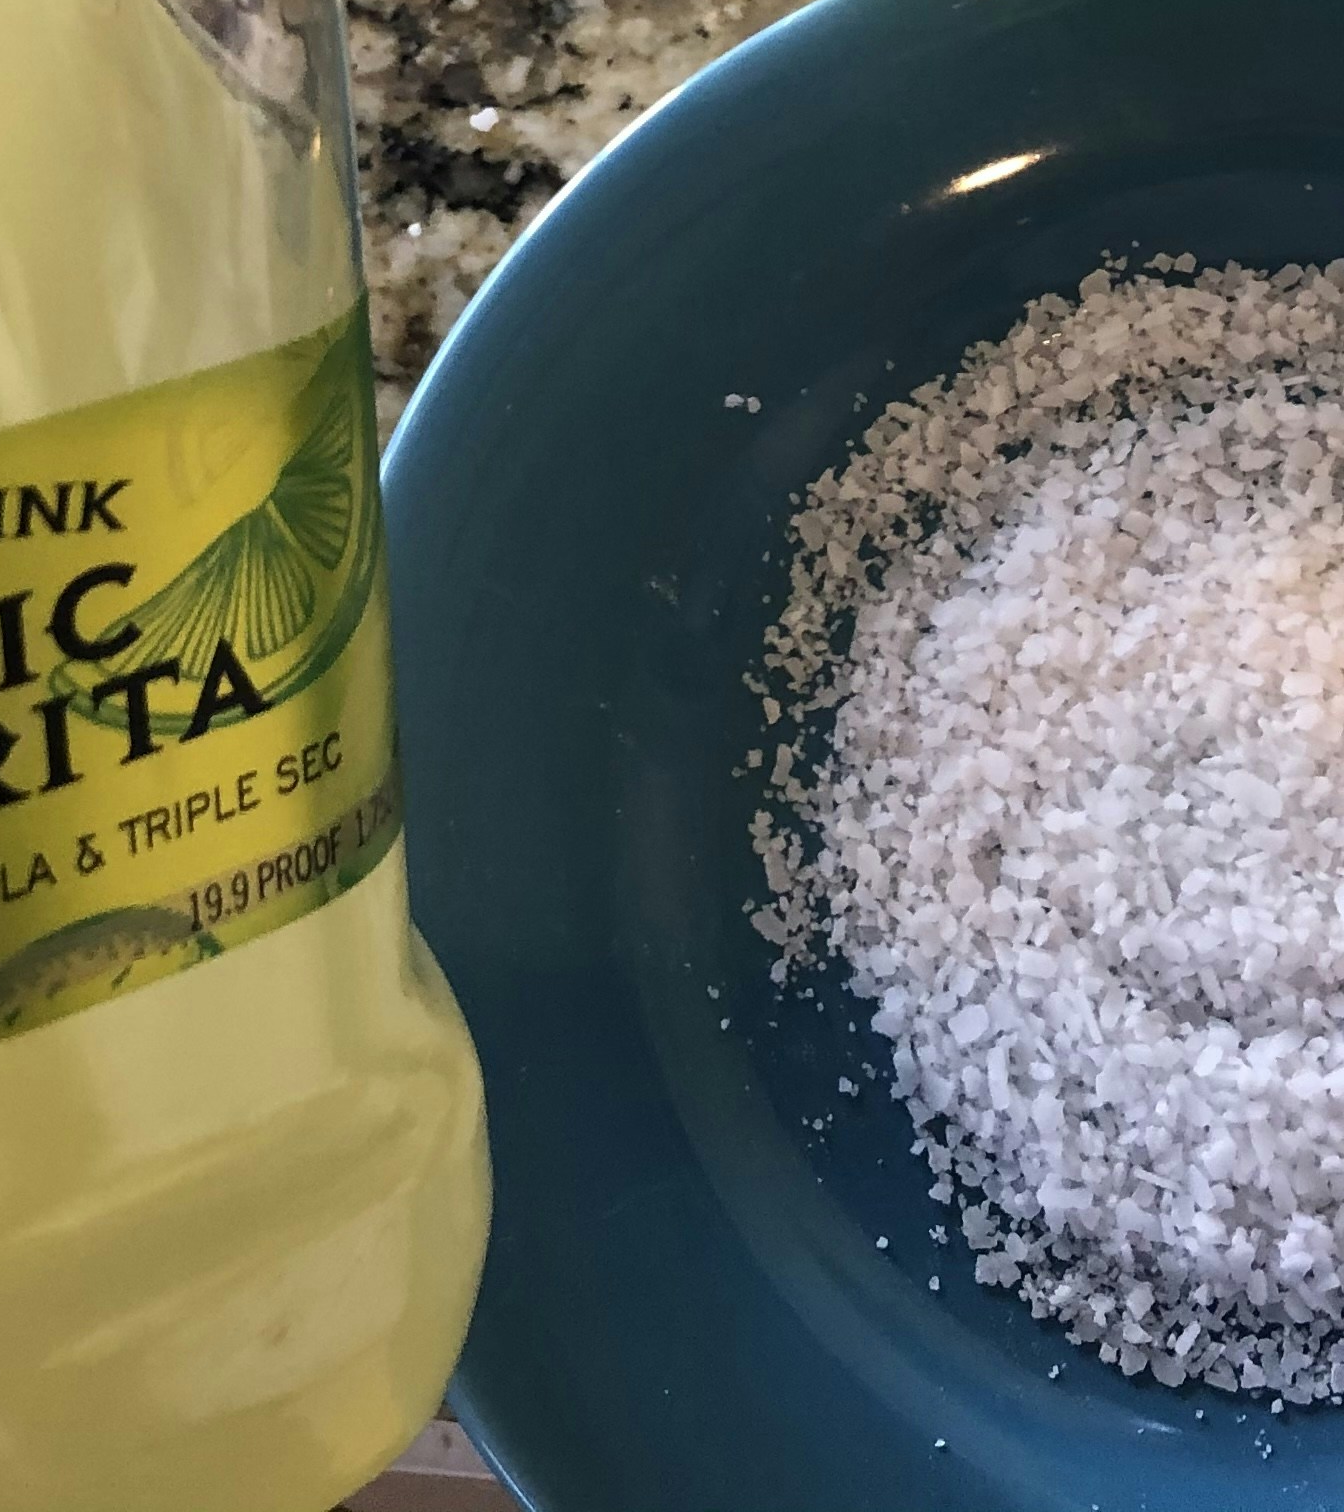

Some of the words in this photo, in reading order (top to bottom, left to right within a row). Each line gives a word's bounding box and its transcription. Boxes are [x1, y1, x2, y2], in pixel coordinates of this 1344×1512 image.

[74, 832, 106, 877] &
[118, 769, 262, 857] TRIPLE
[274, 731, 344, 797] SEC
[188, 869, 250, 932] 19.9
[256, 822, 343, 903] PROOF
